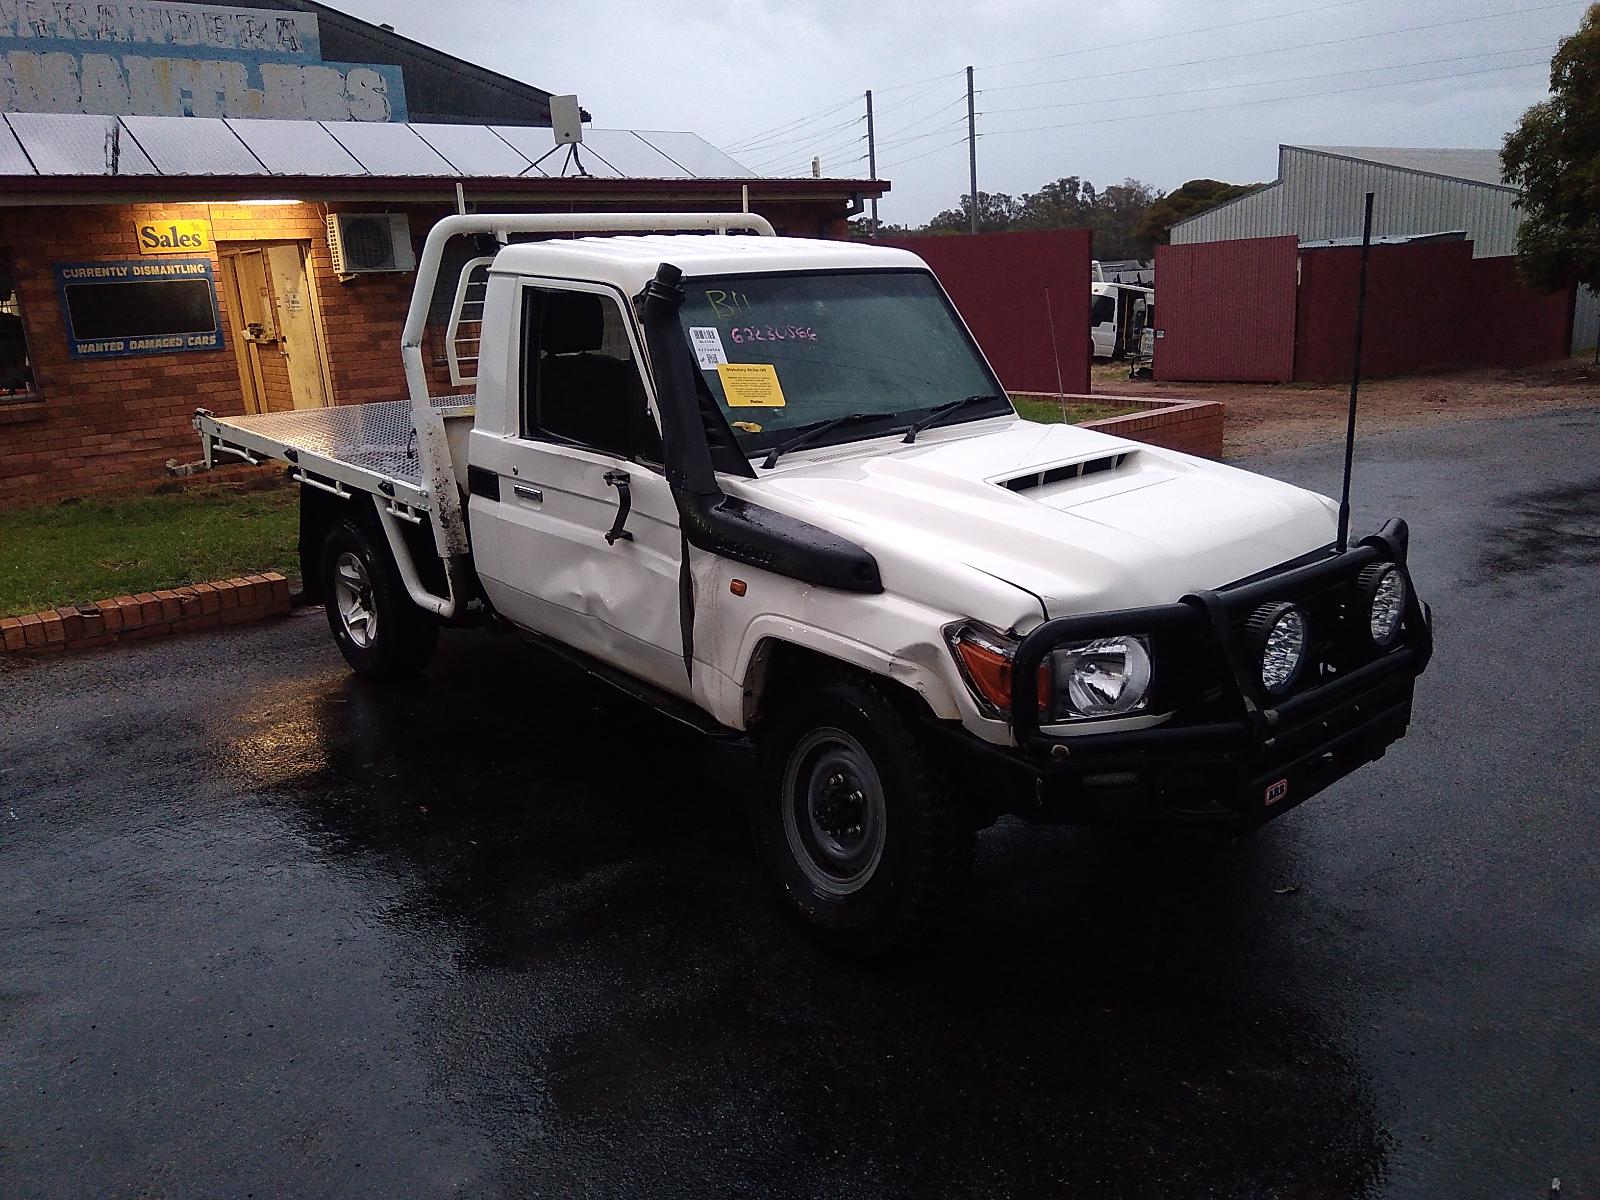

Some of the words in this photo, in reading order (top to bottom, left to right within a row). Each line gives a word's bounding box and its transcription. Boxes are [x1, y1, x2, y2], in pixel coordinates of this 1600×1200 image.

[140, 225, 203, 249] Sales
[63, 265, 128, 279] CURRENTLY
[133, 263, 206, 277] DISMANTLING
[77, 341, 124, 354] WANTED
[129, 338, 183, 351] DAMAGED
[188, 335, 217, 347] CARS
[1268, 784, 1285, 801] ARB
